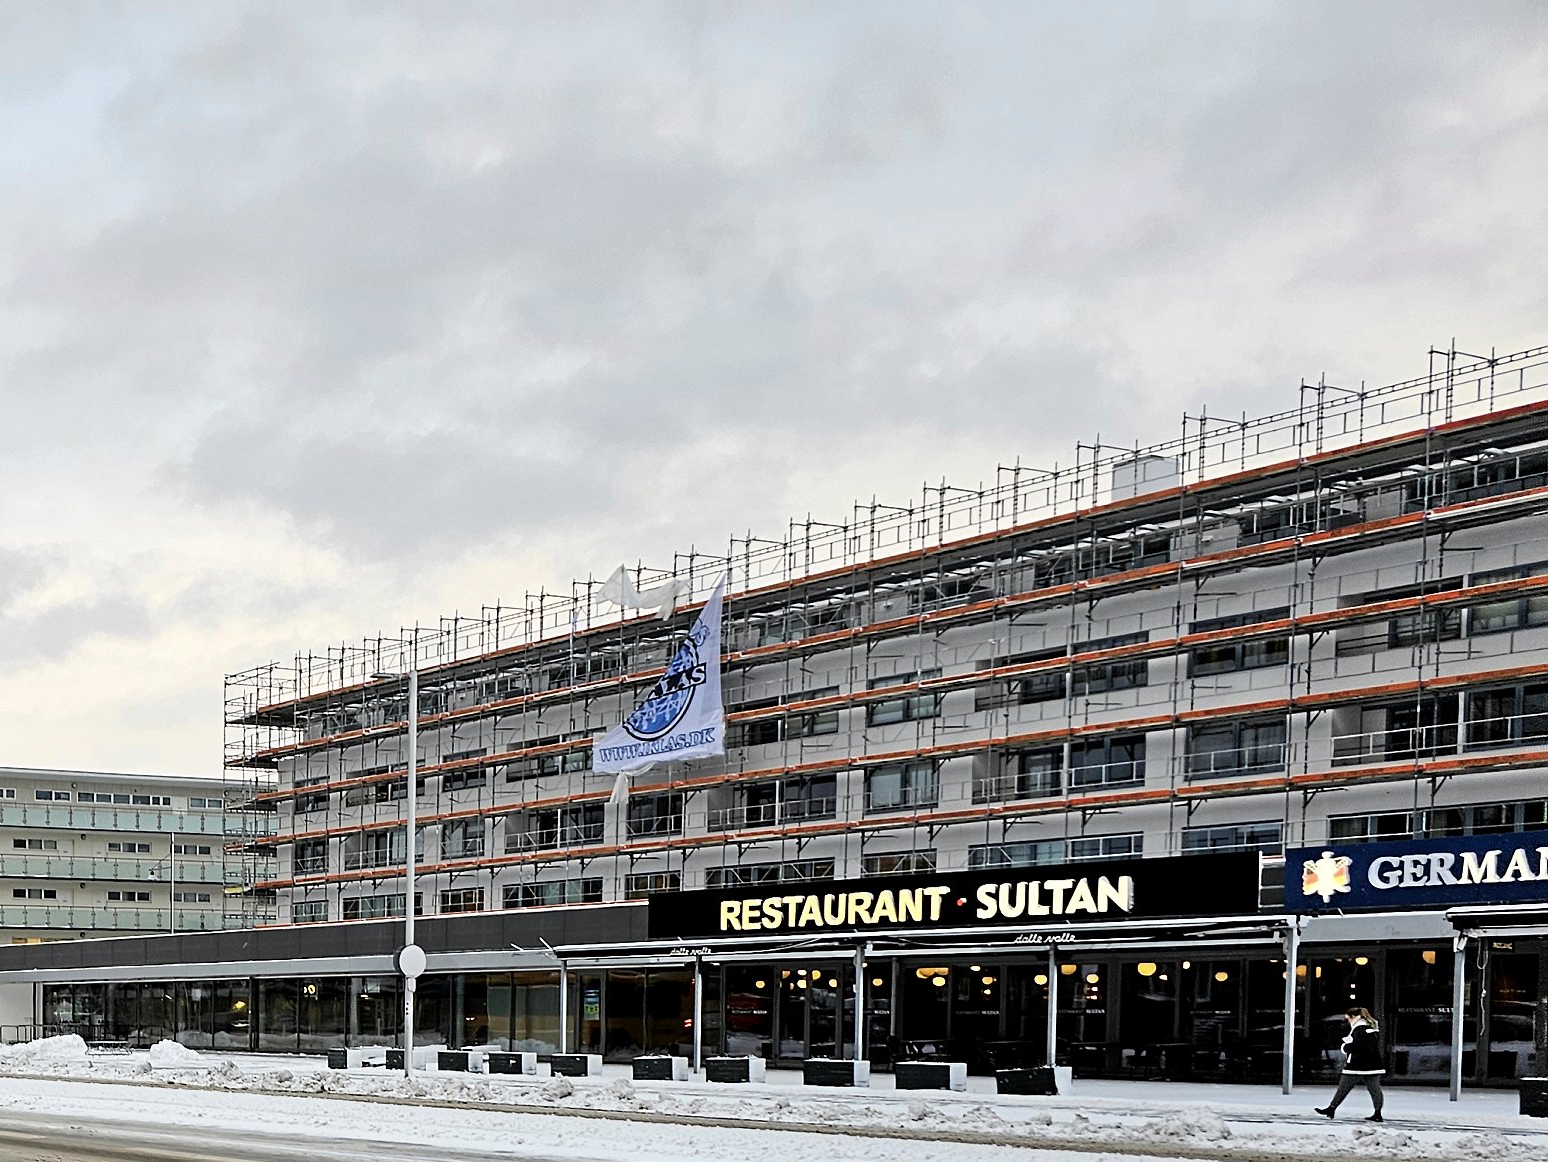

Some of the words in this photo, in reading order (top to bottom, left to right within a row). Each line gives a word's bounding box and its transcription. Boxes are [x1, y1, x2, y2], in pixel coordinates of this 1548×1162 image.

[599, 727, 716, 762] WWW.IKLAS.DK
[720, 884, 951, 931] RESTAURANT
[976, 875, 1136, 920] SULTAN
